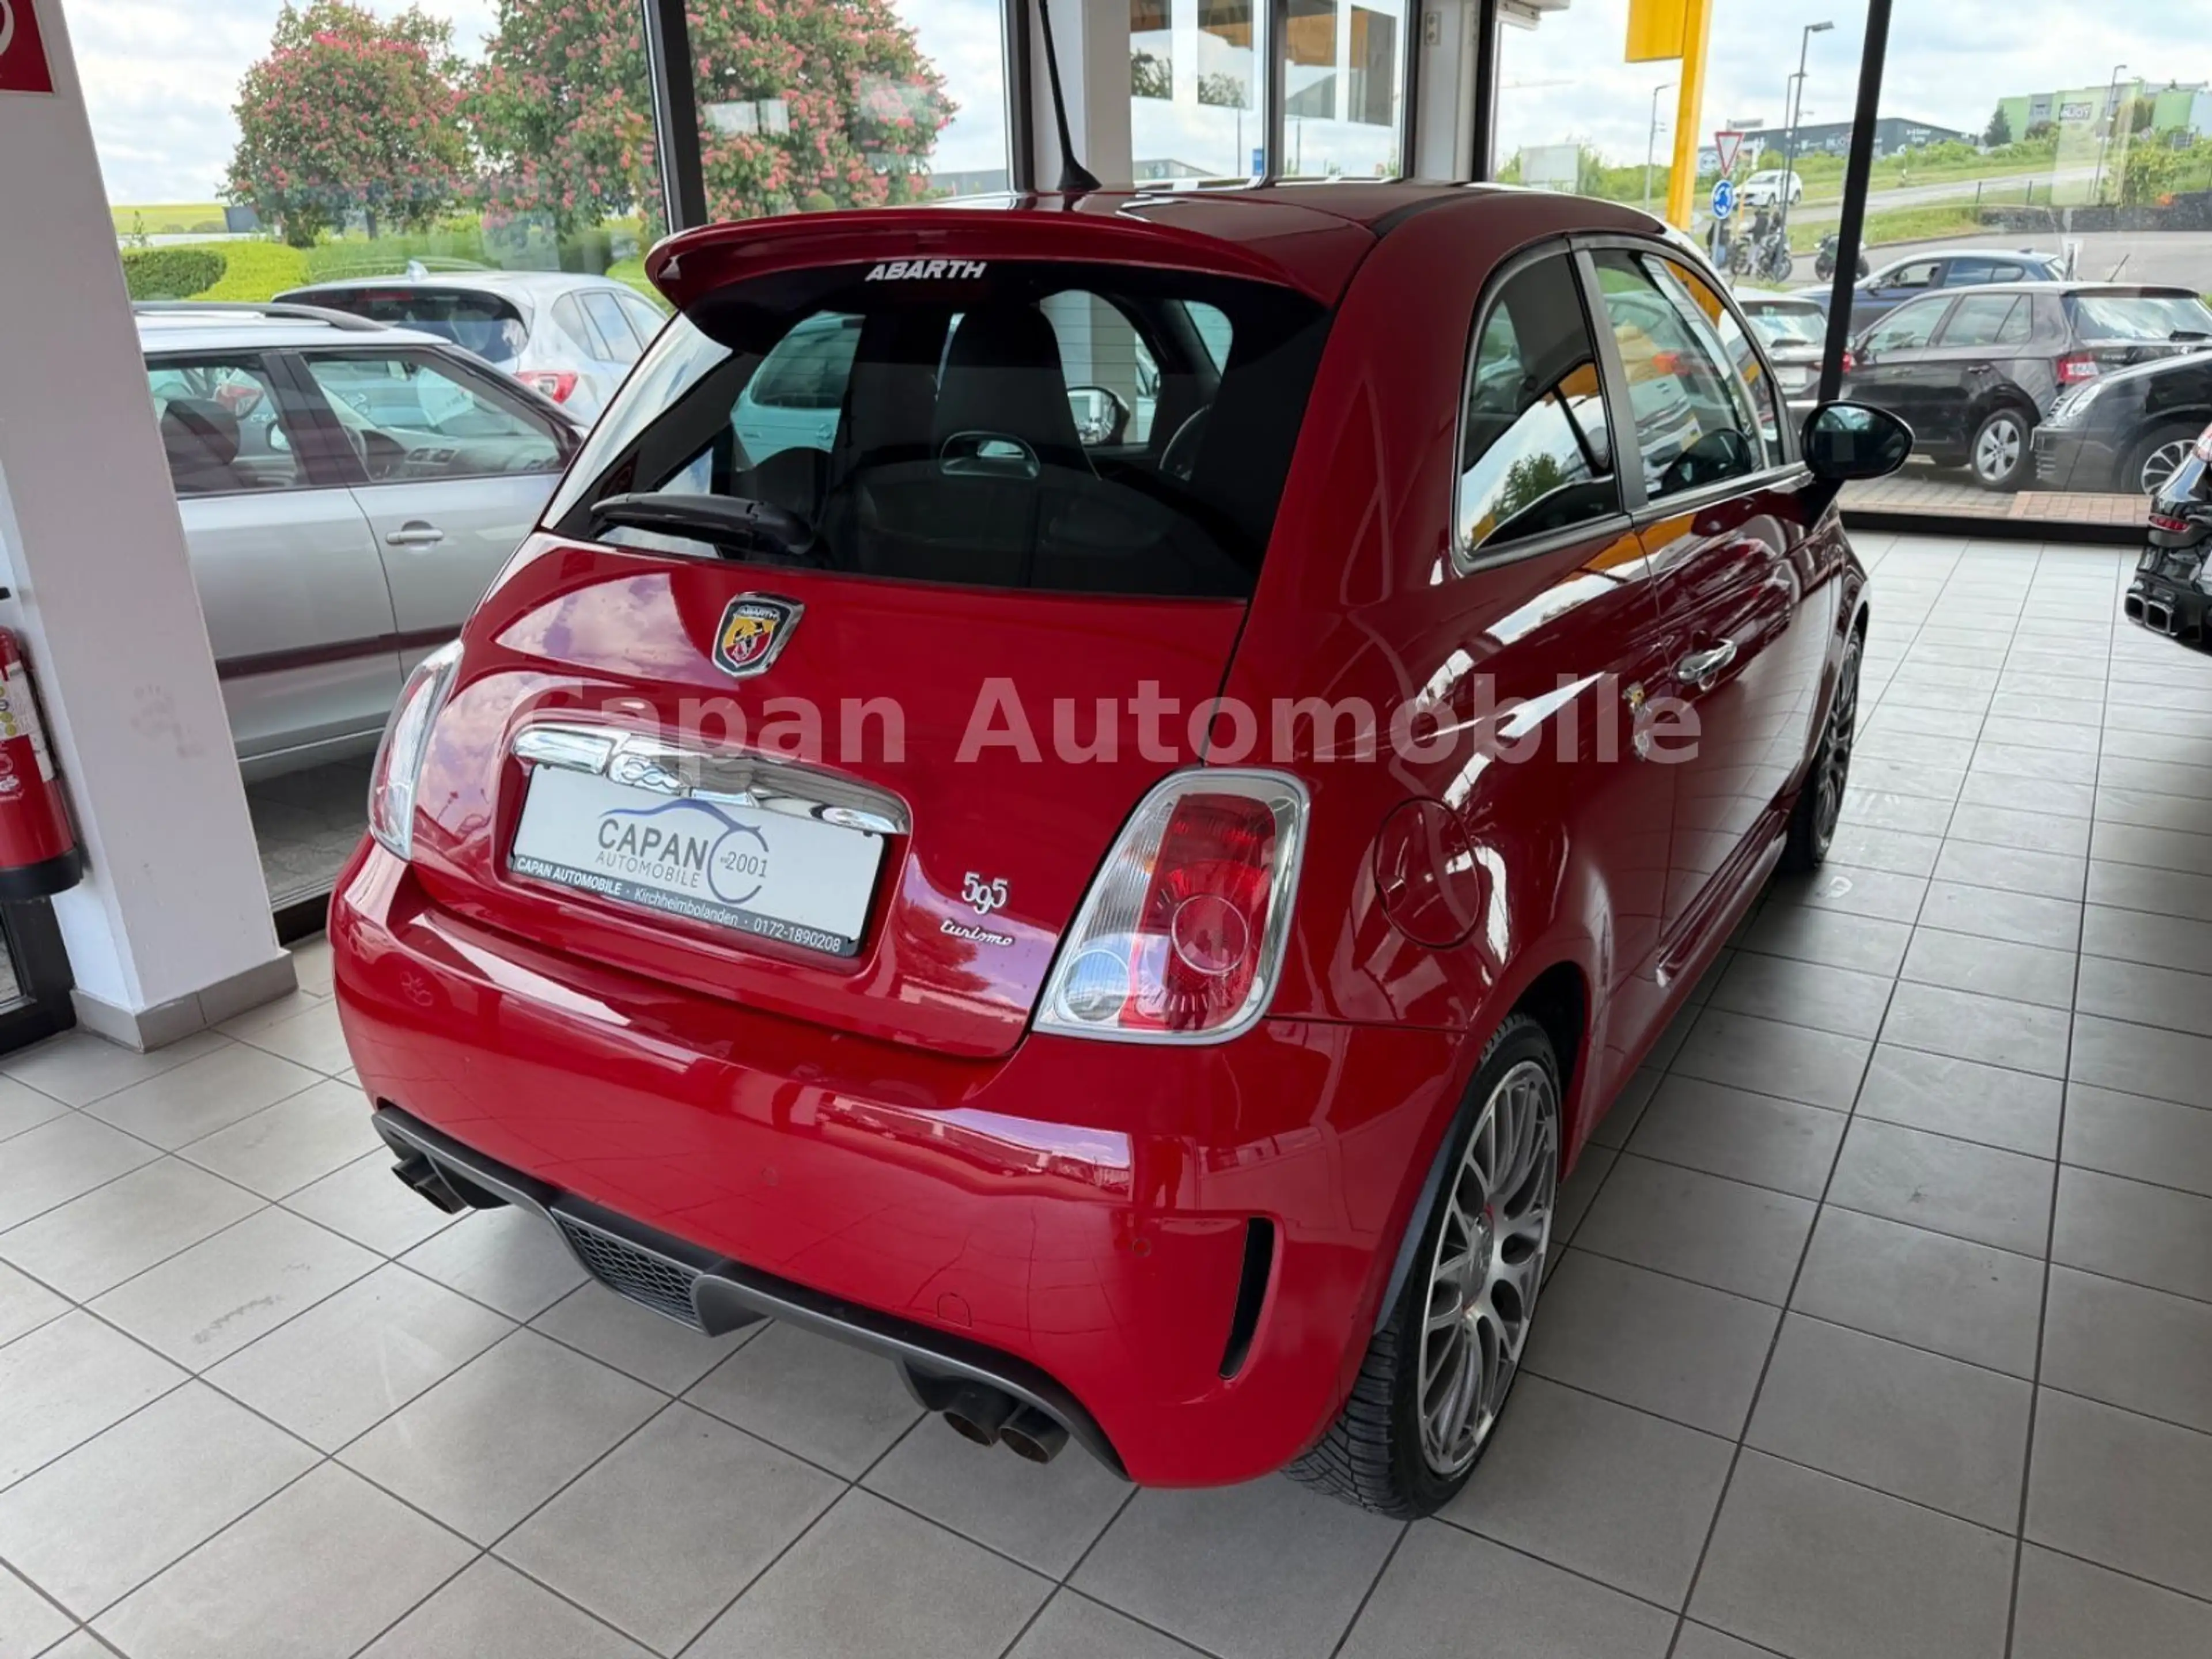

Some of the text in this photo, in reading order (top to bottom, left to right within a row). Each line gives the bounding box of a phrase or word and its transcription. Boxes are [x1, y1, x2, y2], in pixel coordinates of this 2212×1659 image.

[865, 260, 987, 282] ABARTH
[598, 818, 709, 871] CAPAN
[725, 851, 767, 878] 2001
[595, 851, 701, 888] AUTOMOBILE
[517, 857, 842, 952] CAPAN AUTOMOBILE Kirchheimbolanden 0172-1890208
[961, 871, 1008, 915] 595
